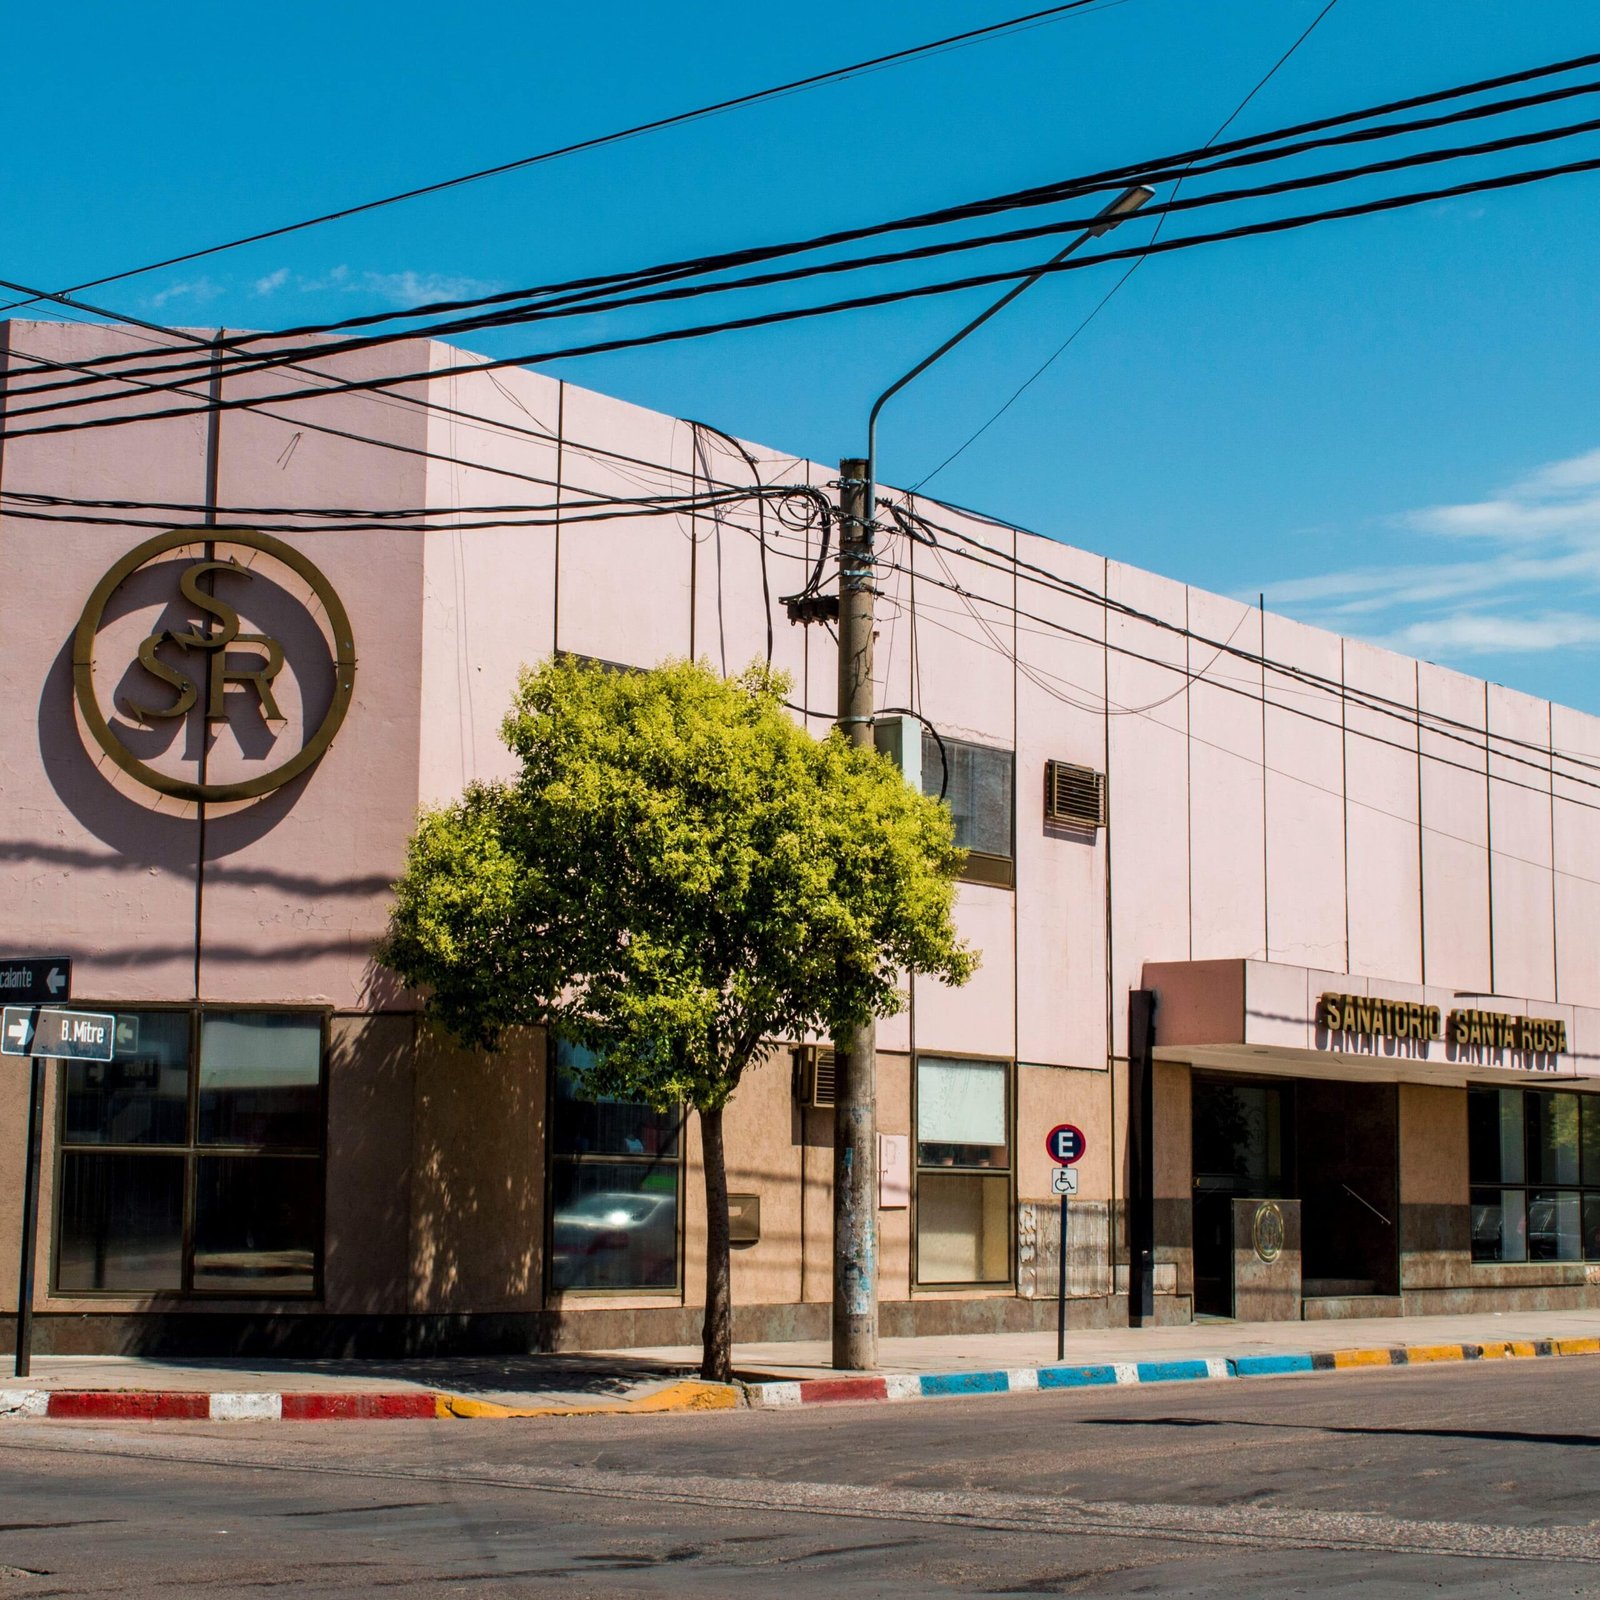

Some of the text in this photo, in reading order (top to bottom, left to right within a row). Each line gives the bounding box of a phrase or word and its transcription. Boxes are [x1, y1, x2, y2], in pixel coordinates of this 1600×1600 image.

[1321, 992, 1567, 1053] SANATORIO SANTA ROSA
[1058, 1132, 1074, 1158] E
